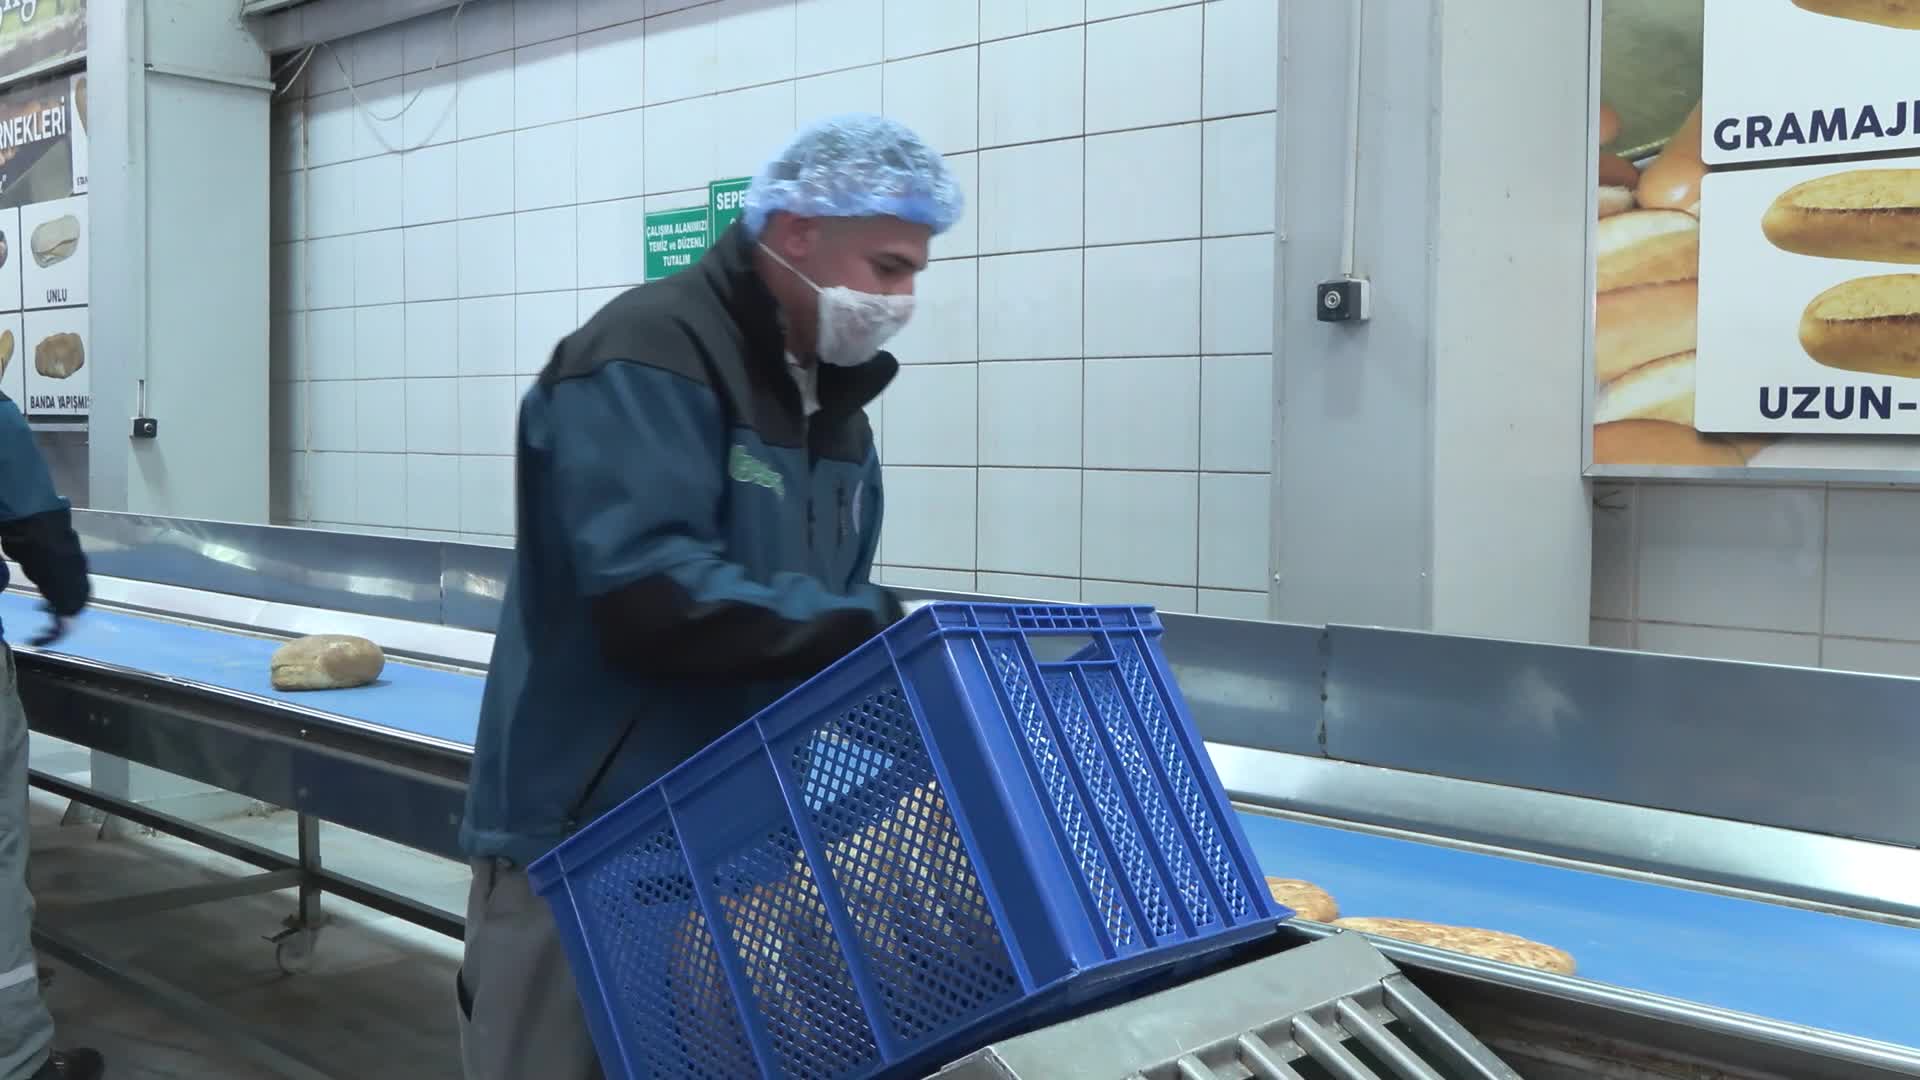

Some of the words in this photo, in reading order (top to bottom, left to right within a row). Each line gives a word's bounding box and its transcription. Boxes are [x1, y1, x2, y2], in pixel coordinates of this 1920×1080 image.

[663, 254, 691, 266] TUTALIM
[46, 288, 68, 303] UNLU
[30, 395, 55, 409] BANDA
[57, 395, 89, 413] YAPIŞMI
